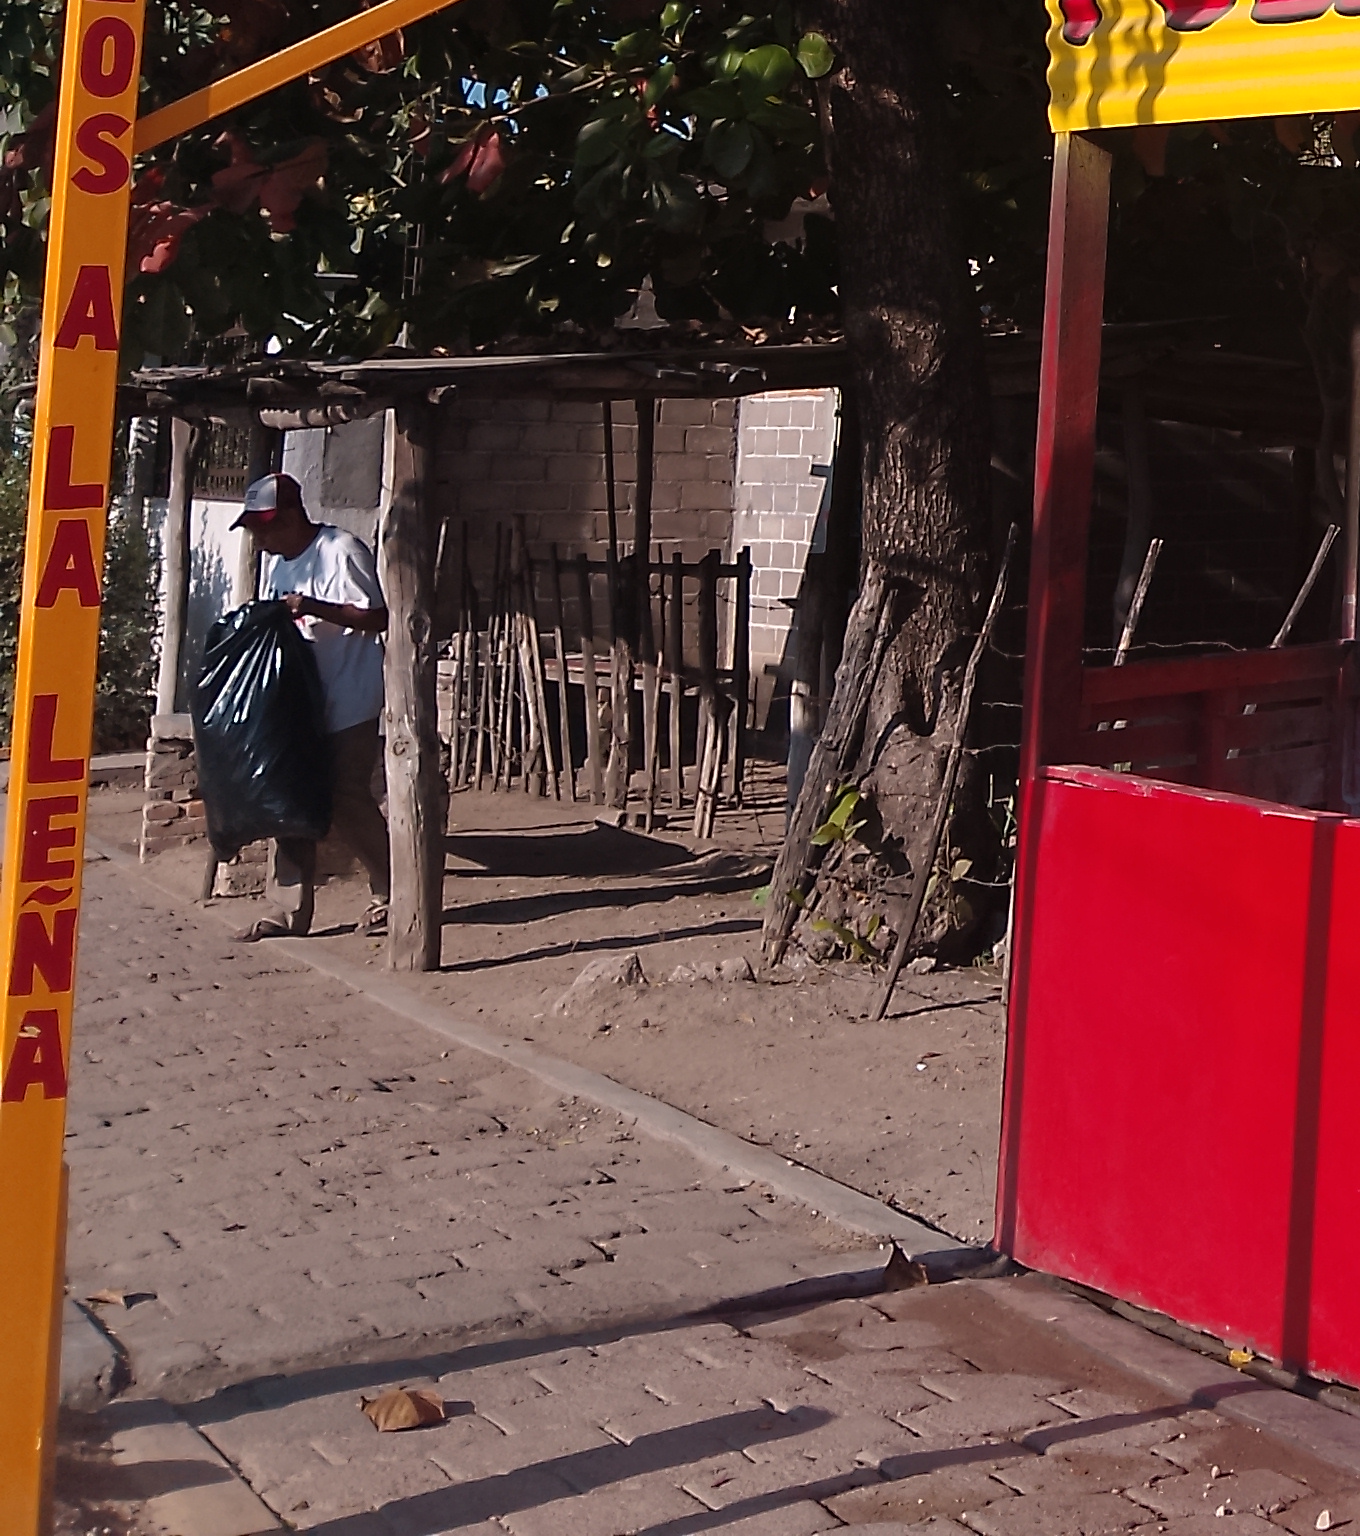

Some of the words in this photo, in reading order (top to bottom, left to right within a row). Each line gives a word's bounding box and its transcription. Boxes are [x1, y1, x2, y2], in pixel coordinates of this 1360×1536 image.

[53, 265, 120, 352] A
[36, 425, 104, 609] LA
[2, 694, 86, 1103] LEÑA
